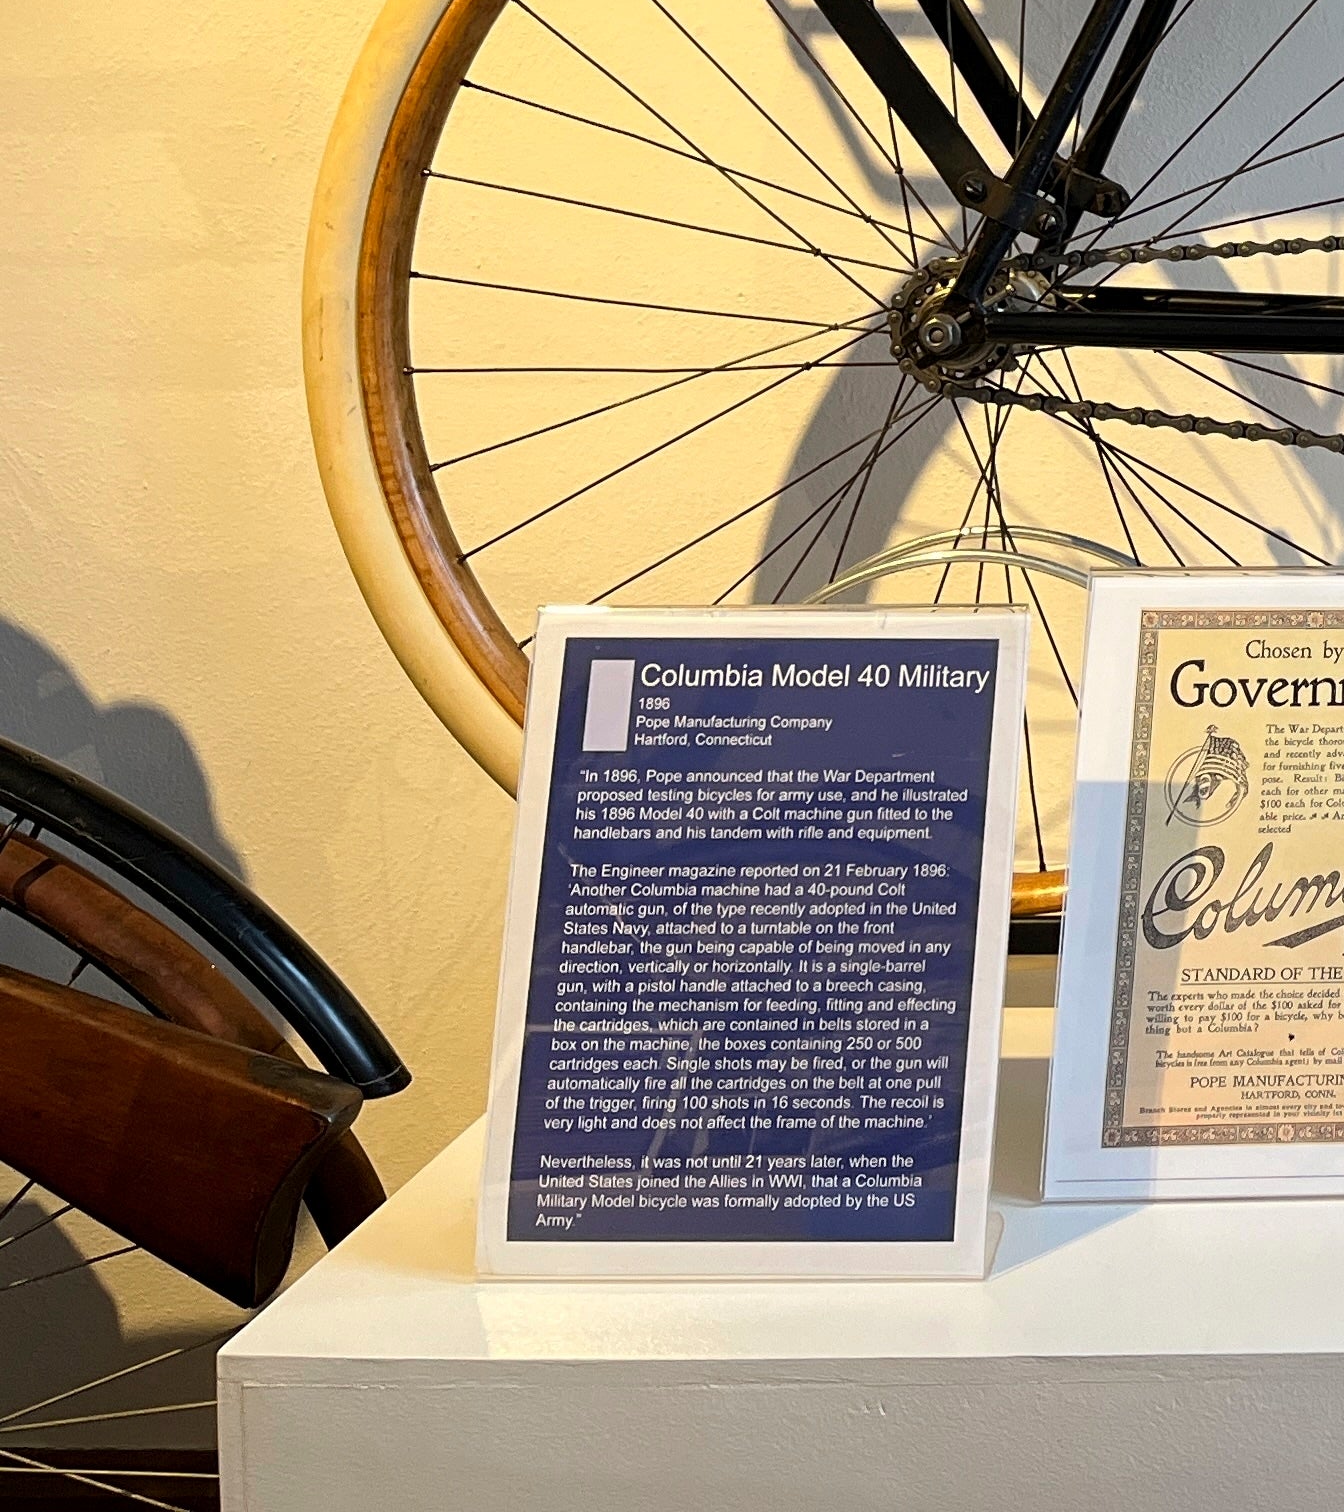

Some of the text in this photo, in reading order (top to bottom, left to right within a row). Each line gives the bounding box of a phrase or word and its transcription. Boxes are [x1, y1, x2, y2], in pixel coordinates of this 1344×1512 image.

[1245, 639, 1312, 659] Chosen
[1322, 639, 1344, 663] by
[640, 663, 990, 693] Columbia Model 40 Military
[638, 696, 670, 710] 1896
[635, 714, 833, 731] Pope Manufacturing Company
[1264, 724, 1285, 734] The
[1287, 724, 1310, 734] War
[633, 731, 772, 747] Hartford, Connecticut
[1264, 736, 1279, 746] the
[1283, 736, 1314, 748] bicycle
[1263, 748, 1281, 759] and
[1285, 748, 1322, 760] recently
[578, 768, 935, 787] “In 1896, Pope announced that the War Department
[575, 787, 968, 805] proposed testing bicycles for army use, and he illustrated
[575, 806, 953, 824] his 1896 Model 40 with a Colt machine gun fitted to the
[573, 823, 933, 842] handlebars and his tandem with rifle and equipment.
[569, 863, 950, 881] The Engineer magazine reported on 21 February 1896:
[567, 882, 906, 899] ‘Another Columbia machine had a 40-pound Colt
[564, 900, 957, 919] automatic gun, of the type recently adopted in the United
[563, 919, 895, 938] States Navy, attached to a turntable on the front
[1181, 967, 1276, 982] STANDARD
[1280, 966, 1303, 981] OF
[1307, 966, 1343, 980] THE
[1145, 1024, 1171, 1037] thing
[1176, 1024, 1192, 1034] but
[1207, 1022, 1259, 1033] Columbia?
[1189, 1075, 1227, 1089] POPE
[540, 1154, 914, 1171] Nevertheless, it was not until 21 years later, when the
[538, 1173, 922, 1191] United States joined the Allies in WWI, that a Columbia
[536, 1191, 915, 1211] Military Model bicycle was formally adopted by the US
[535, 1211, 582, 1230] Army.”
